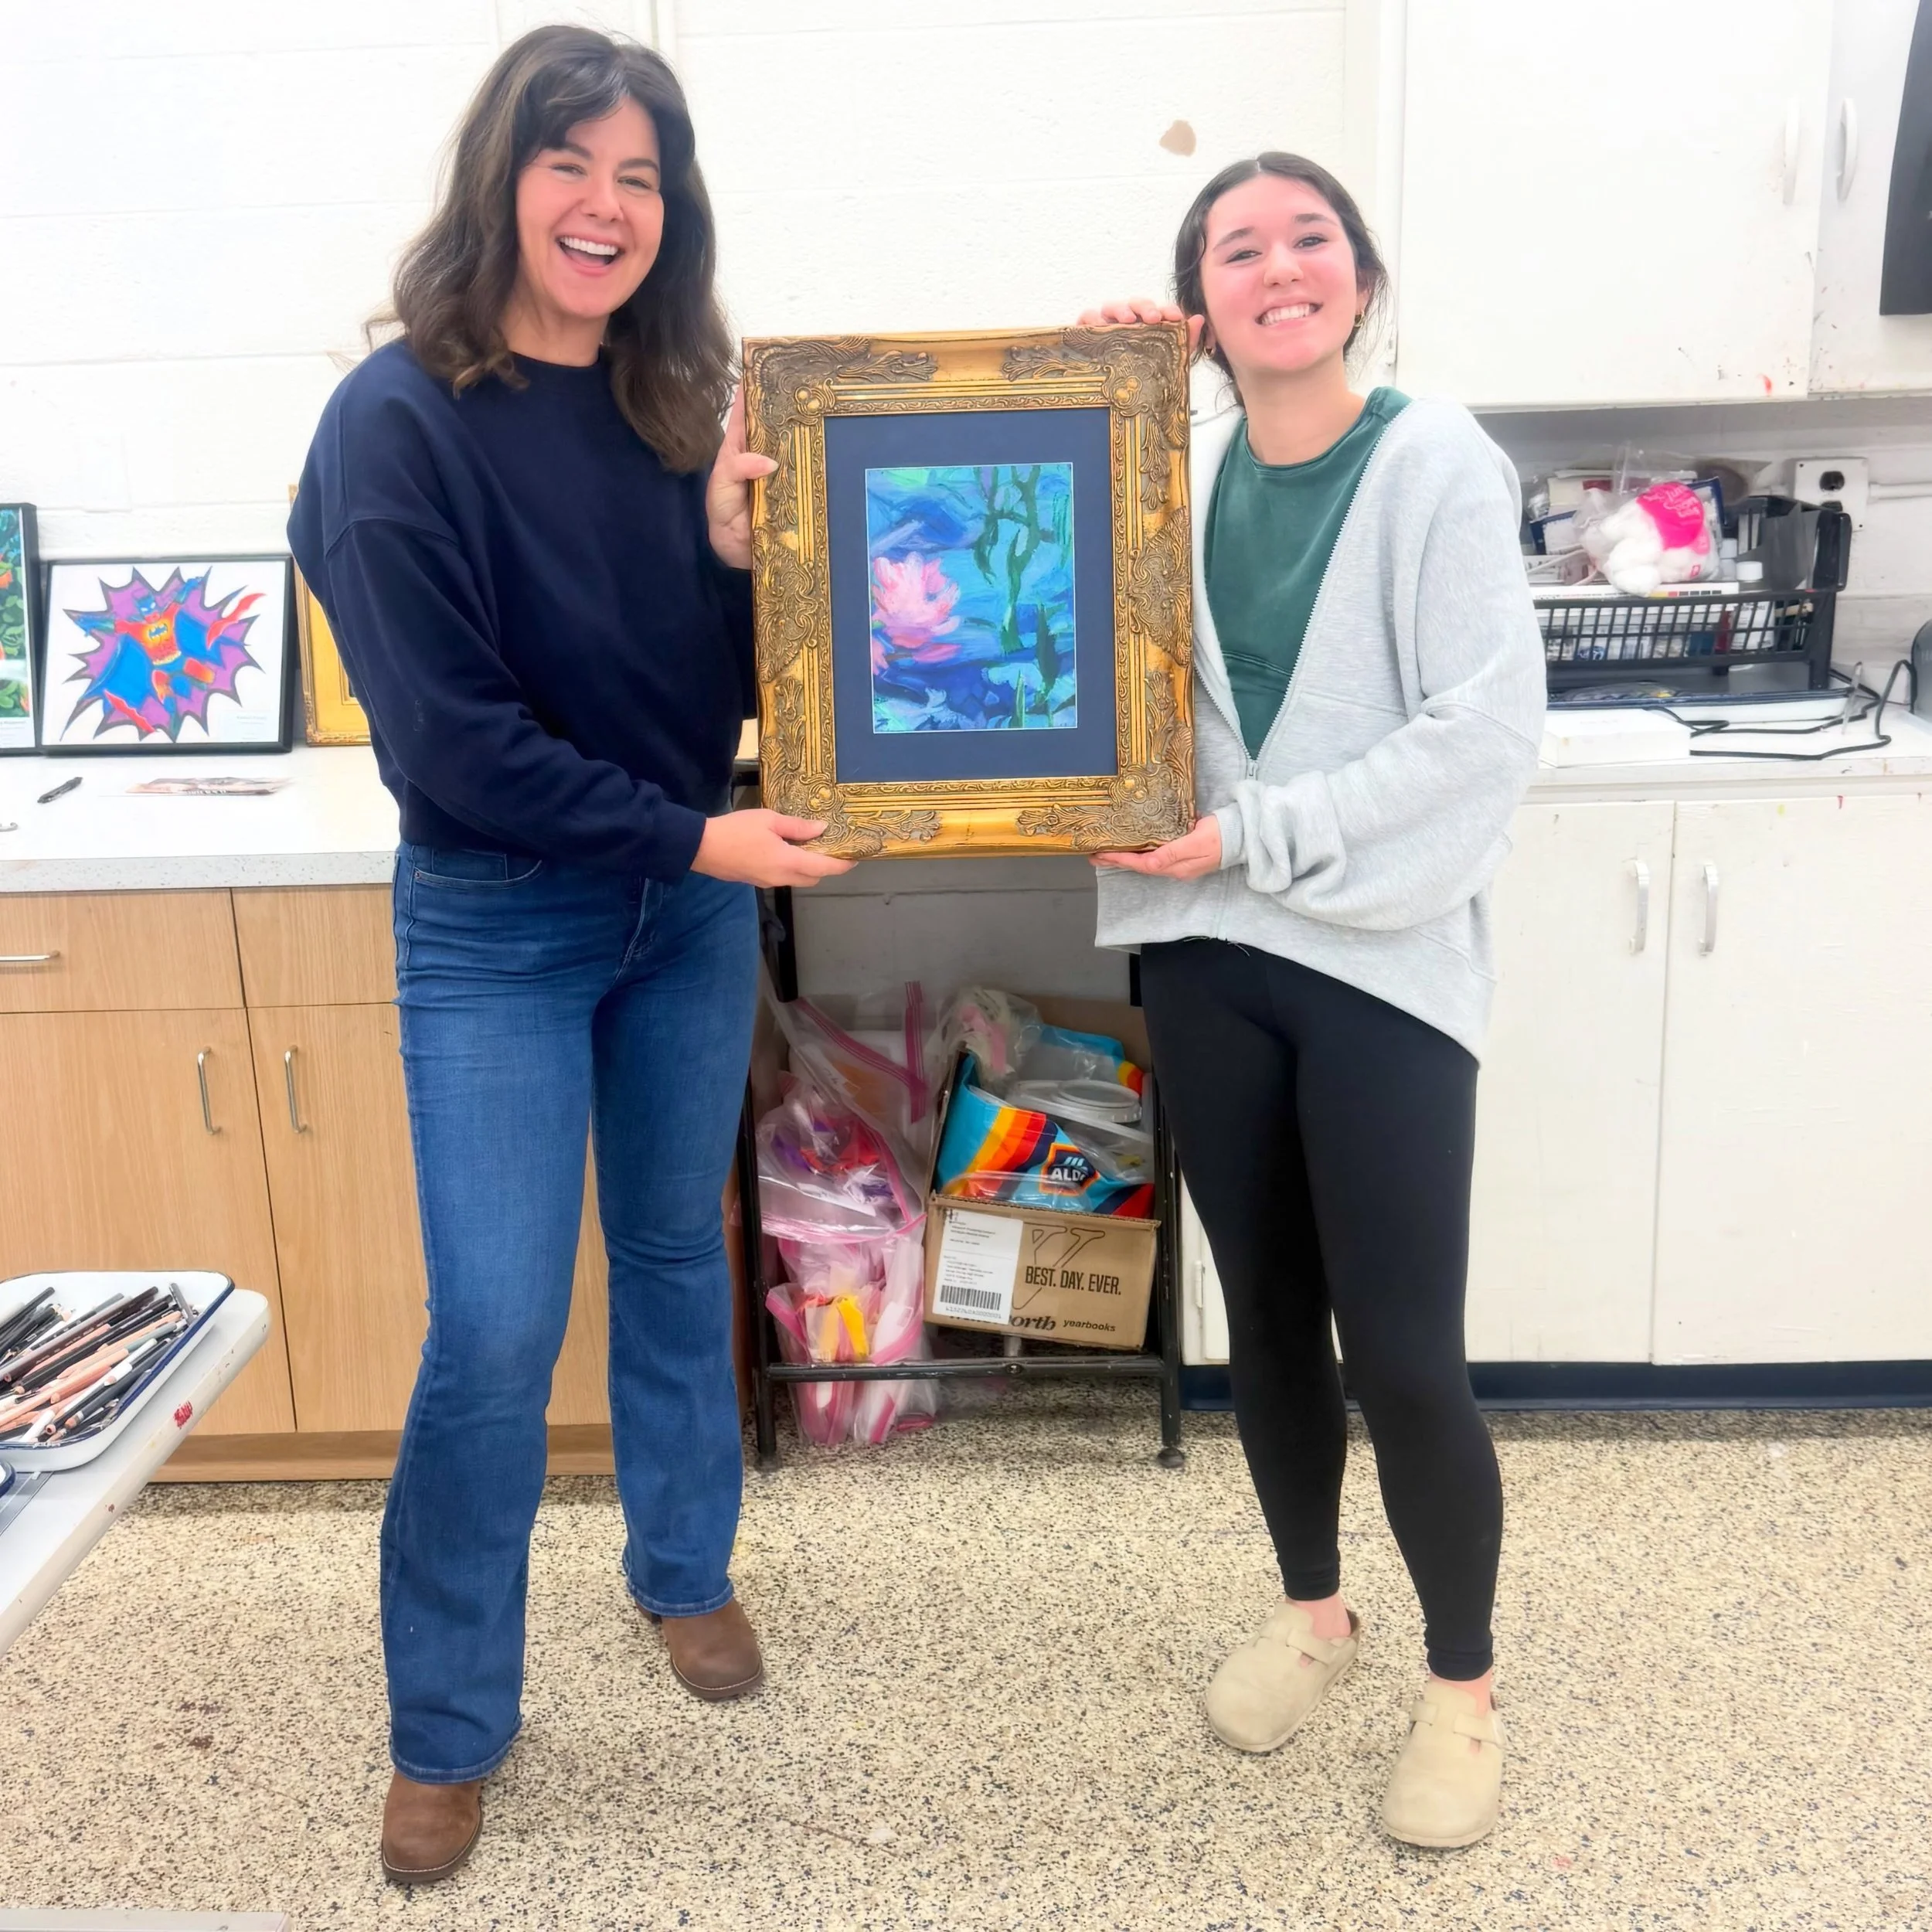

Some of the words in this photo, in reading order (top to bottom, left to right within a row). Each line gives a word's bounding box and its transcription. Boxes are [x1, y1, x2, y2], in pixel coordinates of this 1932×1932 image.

[1025, 1265, 1056, 1287] BEST.
[1060, 1269, 1084, 1291] DAY.
[1087, 1273, 1121, 1296] EVER.
[1063, 1318, 1117, 1332] yearbooks
